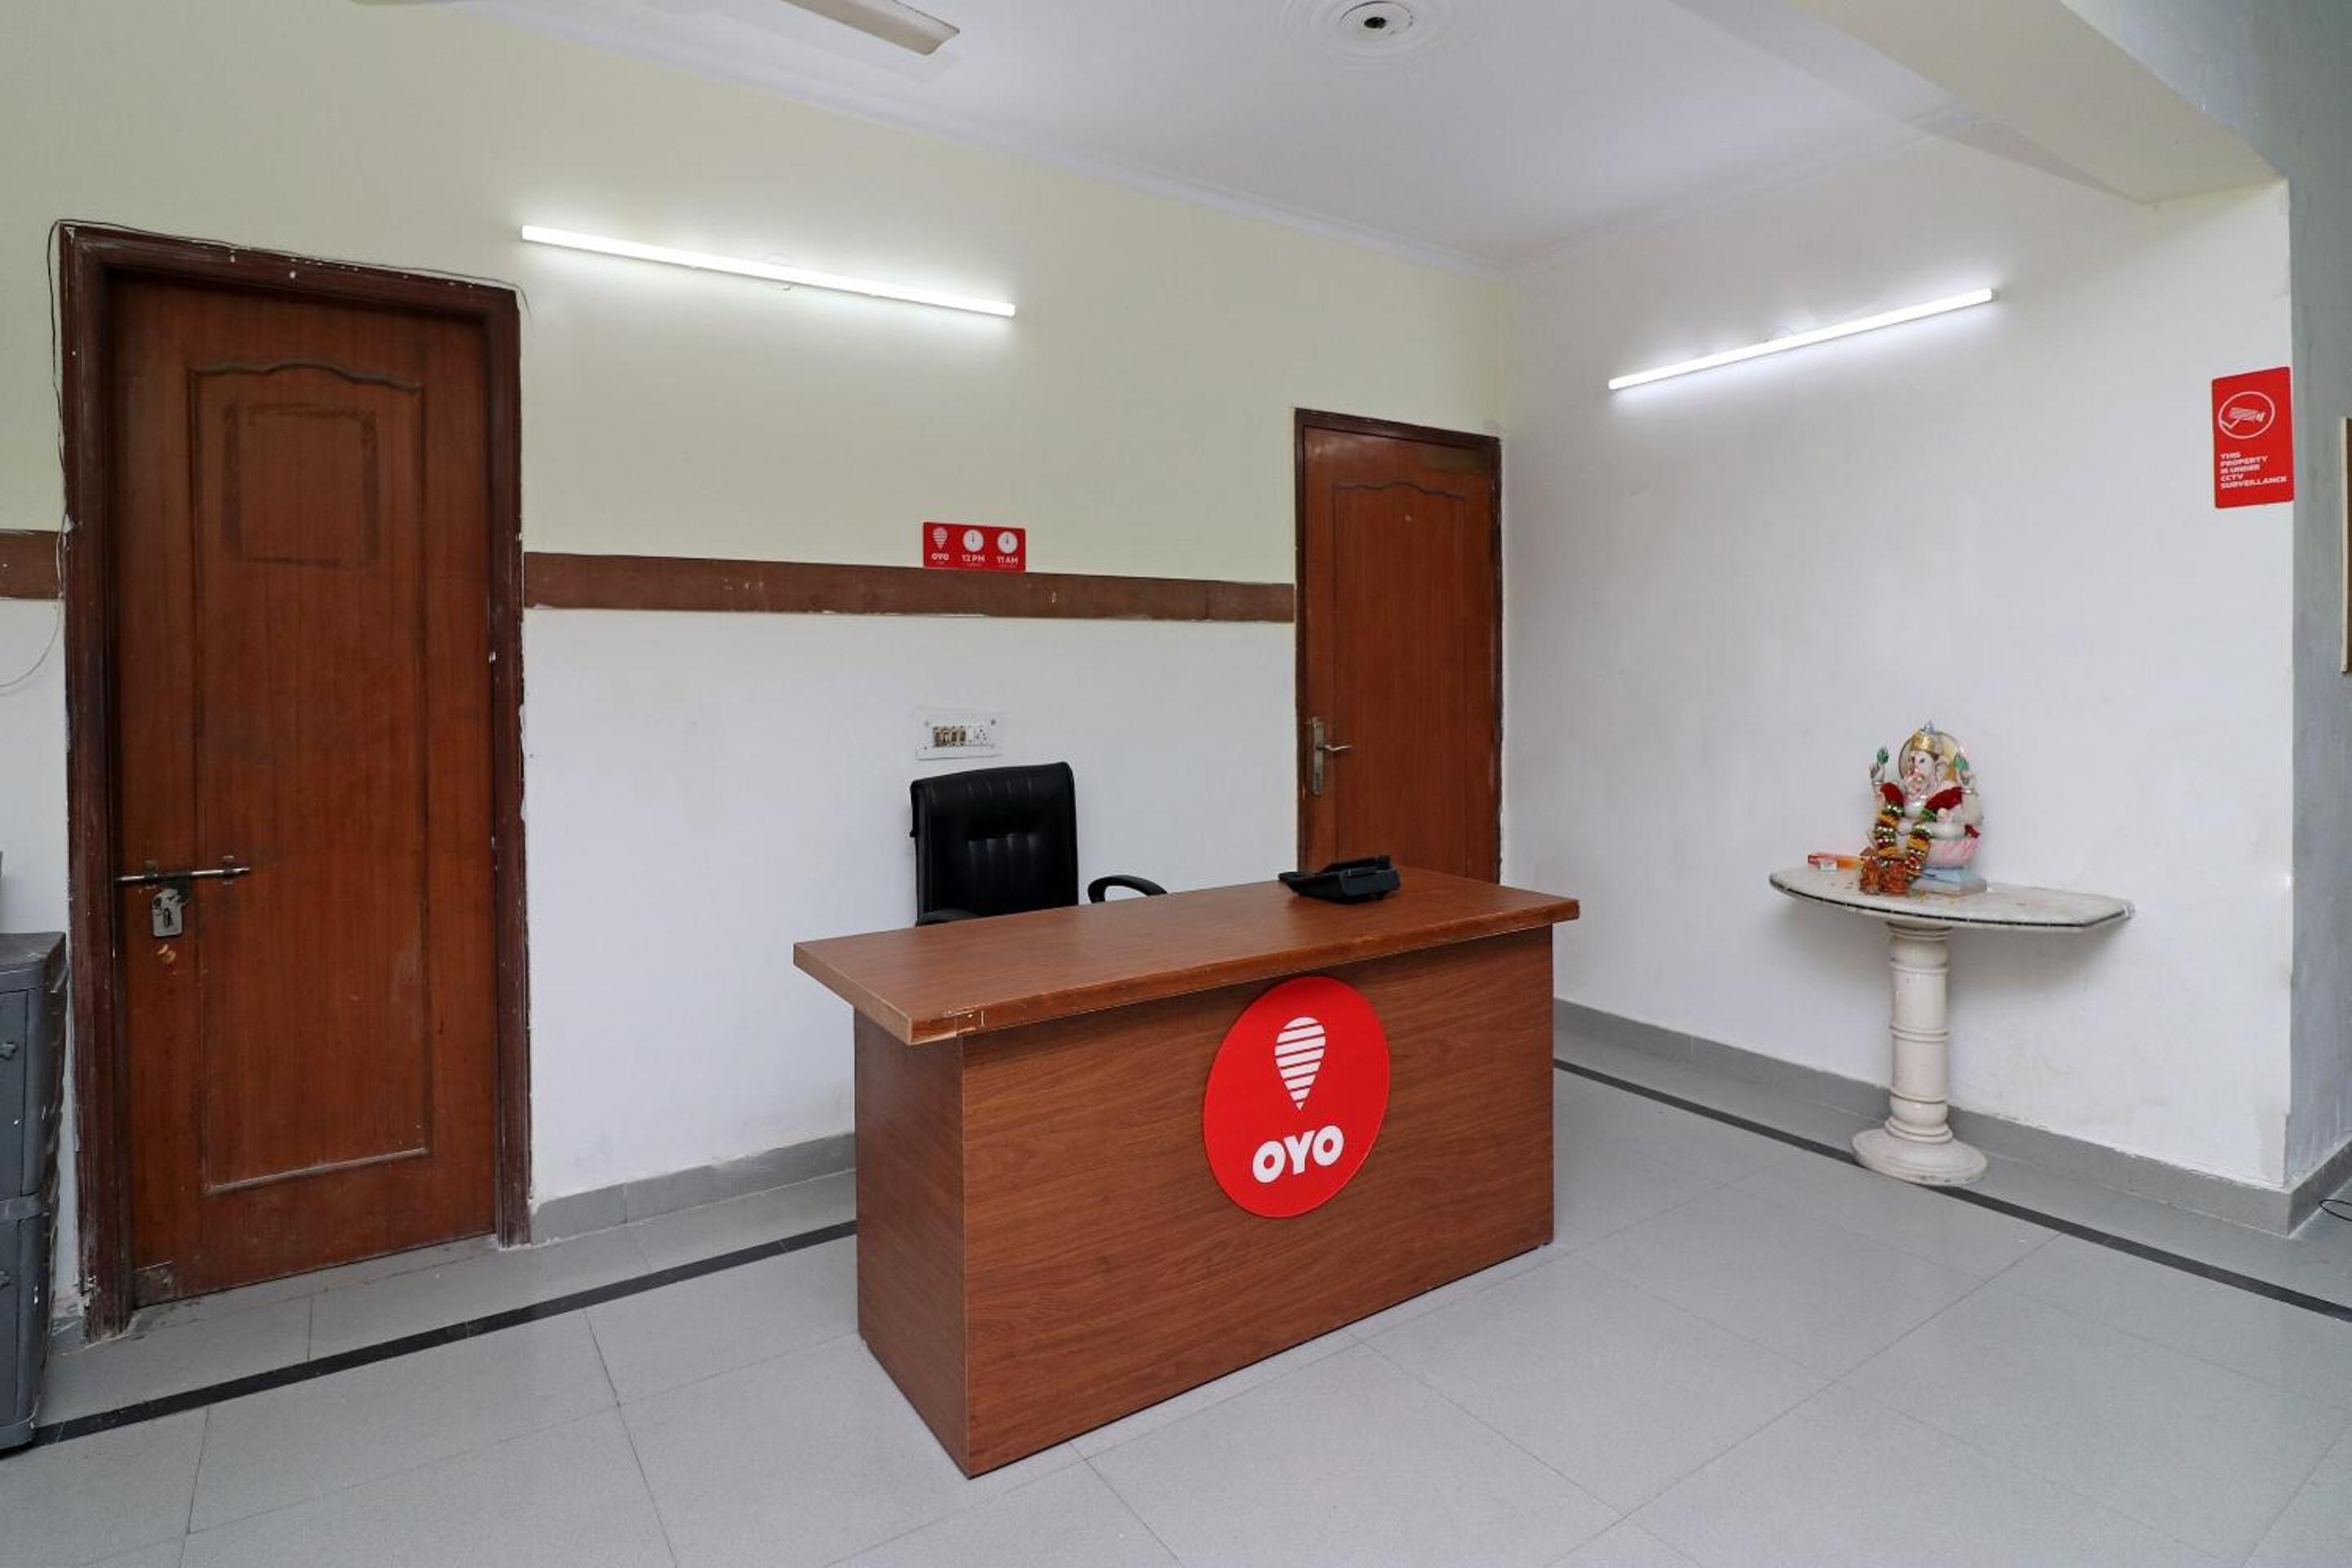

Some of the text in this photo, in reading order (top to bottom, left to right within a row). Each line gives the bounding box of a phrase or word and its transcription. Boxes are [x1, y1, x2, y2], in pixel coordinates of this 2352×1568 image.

[2220, 451, 2241, 460] THIS
[2220, 456, 2268, 468] PROPERTY
[2230, 464, 2261, 474] UNDER
[2220, 473, 2244, 482] CCTV
[2220, 476, 2287, 489] SURVEILLANCE
[931, 552, 950, 561] OYO
[962, 555, 986, 563] 12 PM
[996, 555, 1018, 565] 11 AM
[1252, 1125, 1345, 1183] OYO
